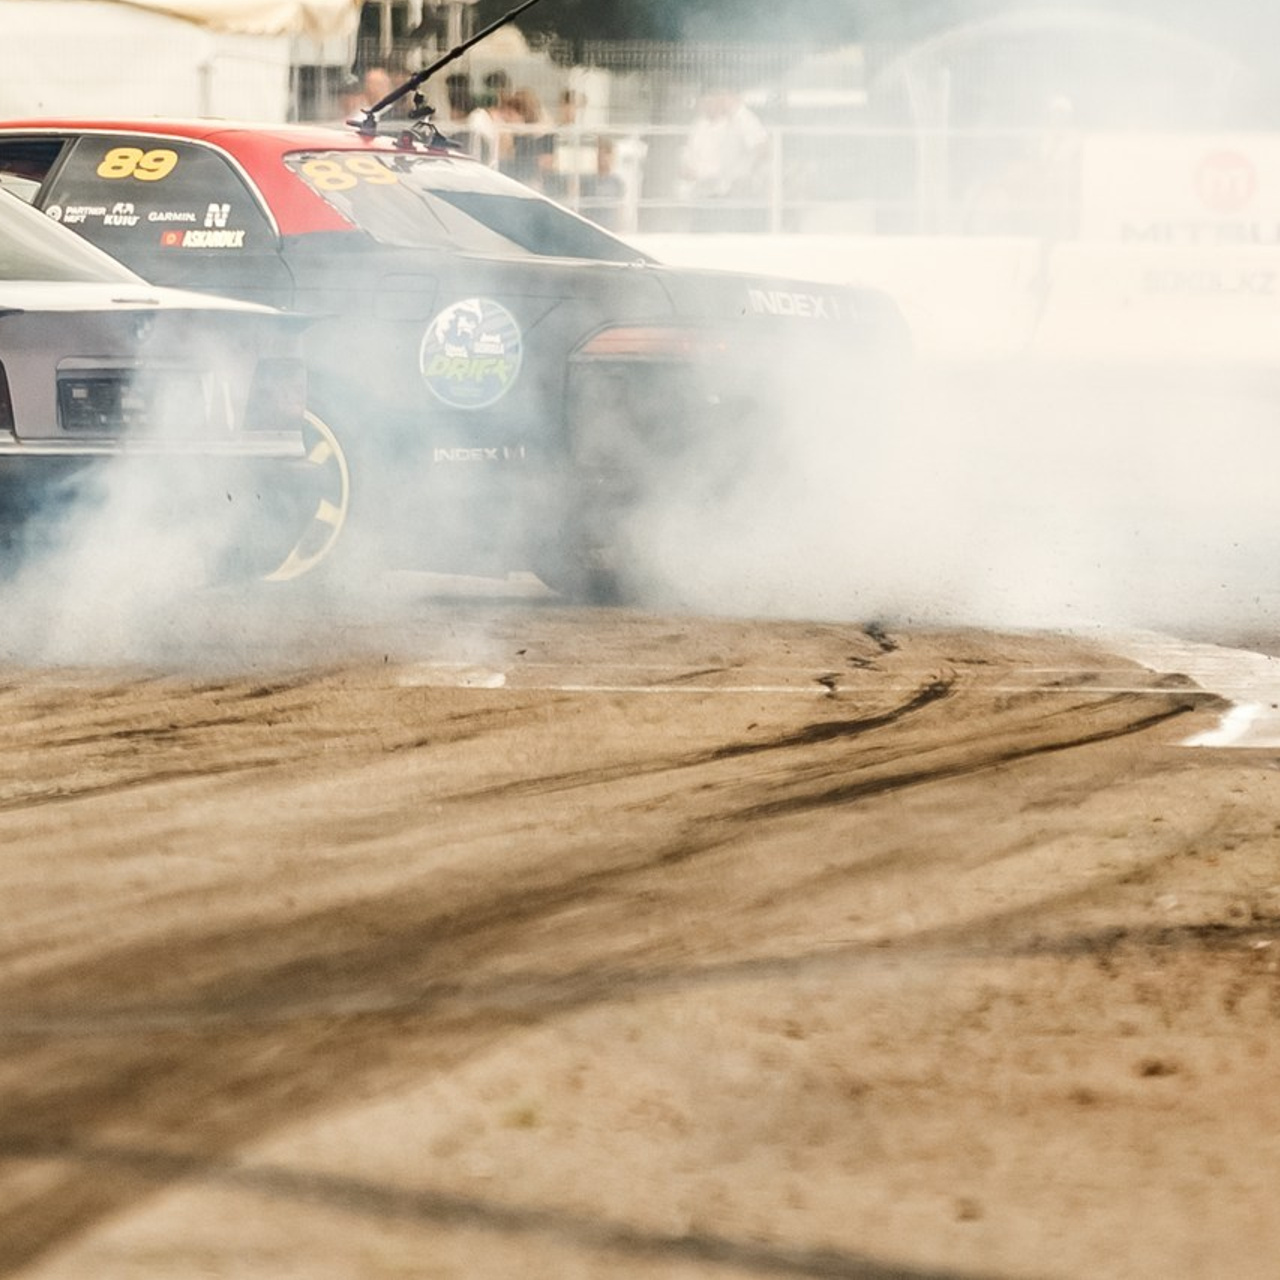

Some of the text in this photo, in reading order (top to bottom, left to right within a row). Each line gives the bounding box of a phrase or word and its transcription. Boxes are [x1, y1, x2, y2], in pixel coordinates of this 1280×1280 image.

[96, 147, 179, 182] 89
[300, 156, 399, 191] 89
[747, 288, 830, 320] INDEX
[433, 447, 499, 463] INDEX
